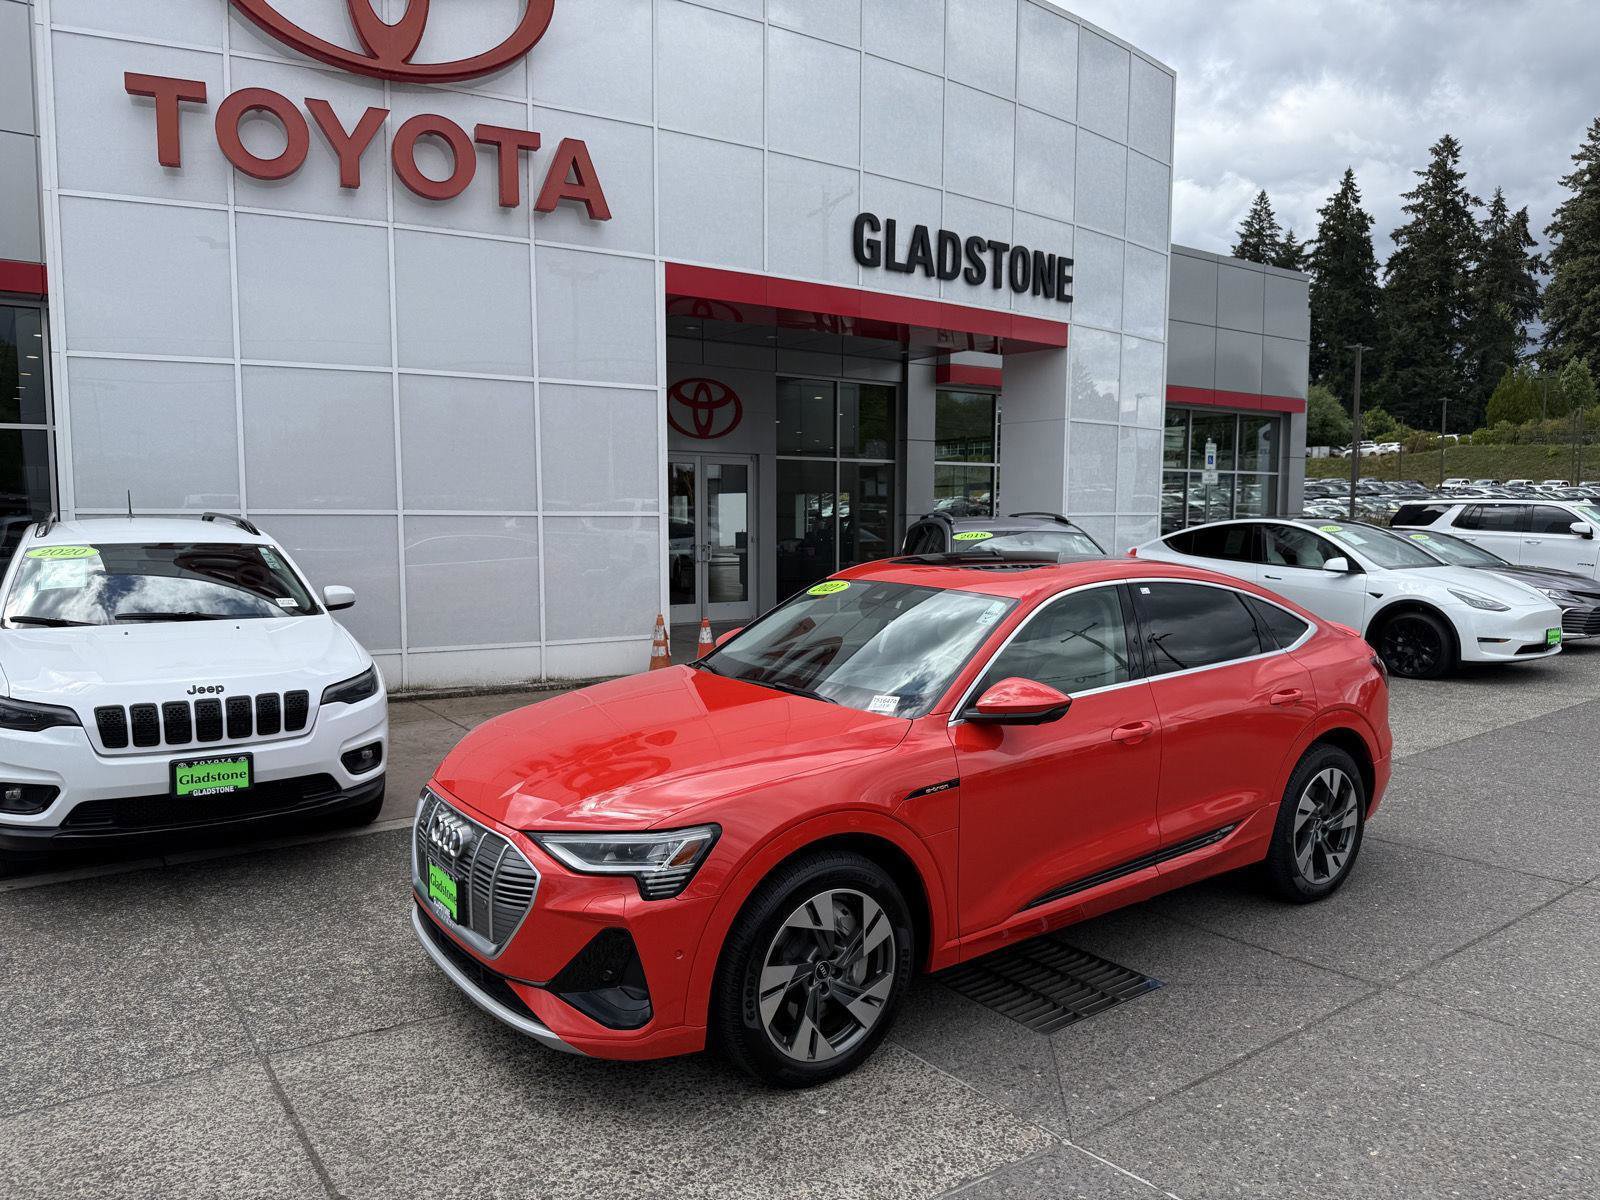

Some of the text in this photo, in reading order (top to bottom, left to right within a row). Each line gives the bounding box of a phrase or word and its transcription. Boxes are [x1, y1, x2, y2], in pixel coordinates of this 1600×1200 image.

[124, 71, 612, 222] TOYOTA
[853, 212, 1074, 303] GLADSTONE
[37, 548, 88, 556] 2020
[187, 684, 225, 695] Jeep
[193, 758, 233, 766] TOYOTA
[179, 770, 247, 785] Gladstone
[193, 786, 235, 796] GLADSTONE
[925, 784, 949, 793] e-tron
[430, 873, 456, 903] Gladstone
